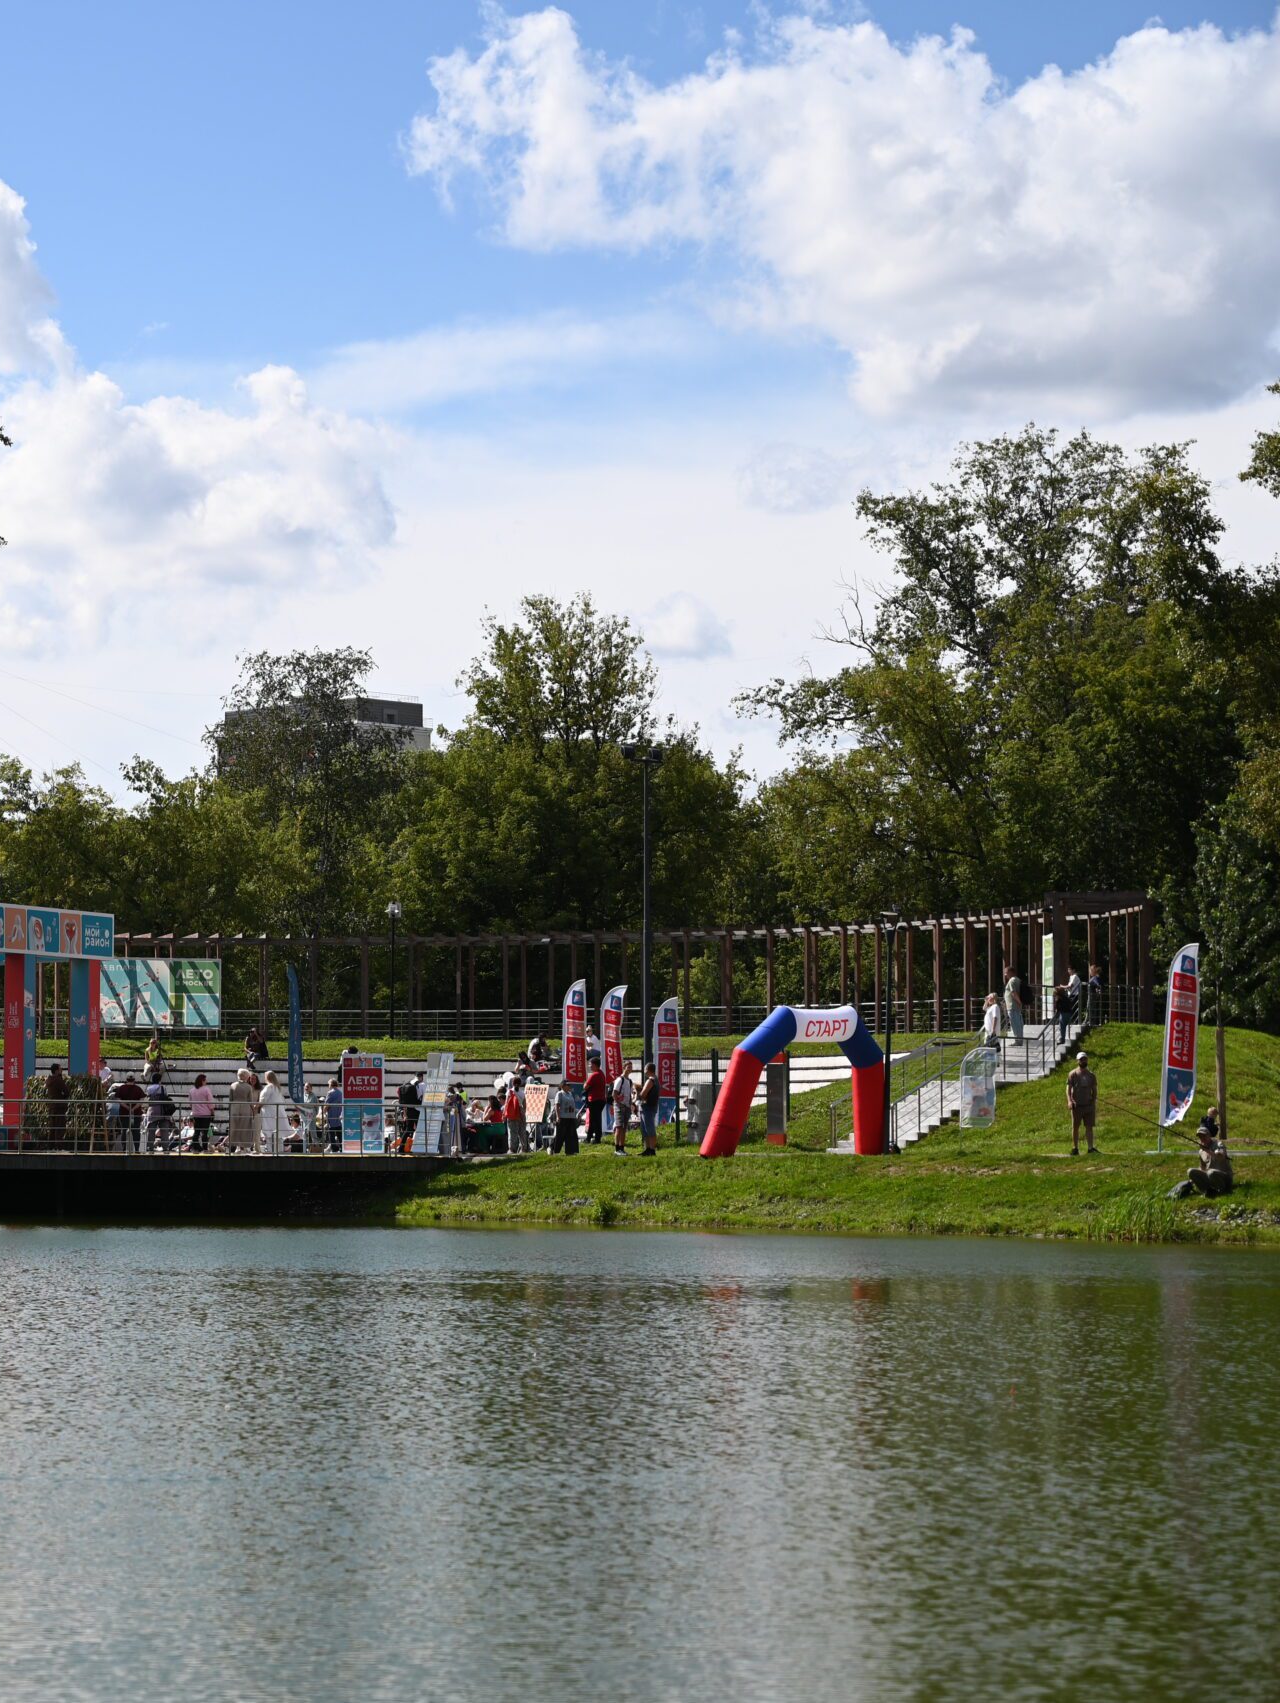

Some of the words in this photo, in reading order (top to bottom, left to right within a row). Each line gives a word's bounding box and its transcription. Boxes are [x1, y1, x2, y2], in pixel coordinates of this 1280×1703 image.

[176, 969, 213, 979] ЛЕТО
[805, 1019, 848, 1037] СТАРТ
[1173, 1019, 1183, 1060] ЛЕТО
[607, 1046, 615, 1079] ЛЕТО
[662, 1059, 670, 1090] ЛЕТО
[348, 1076, 378, 1085] ЛЕТО
